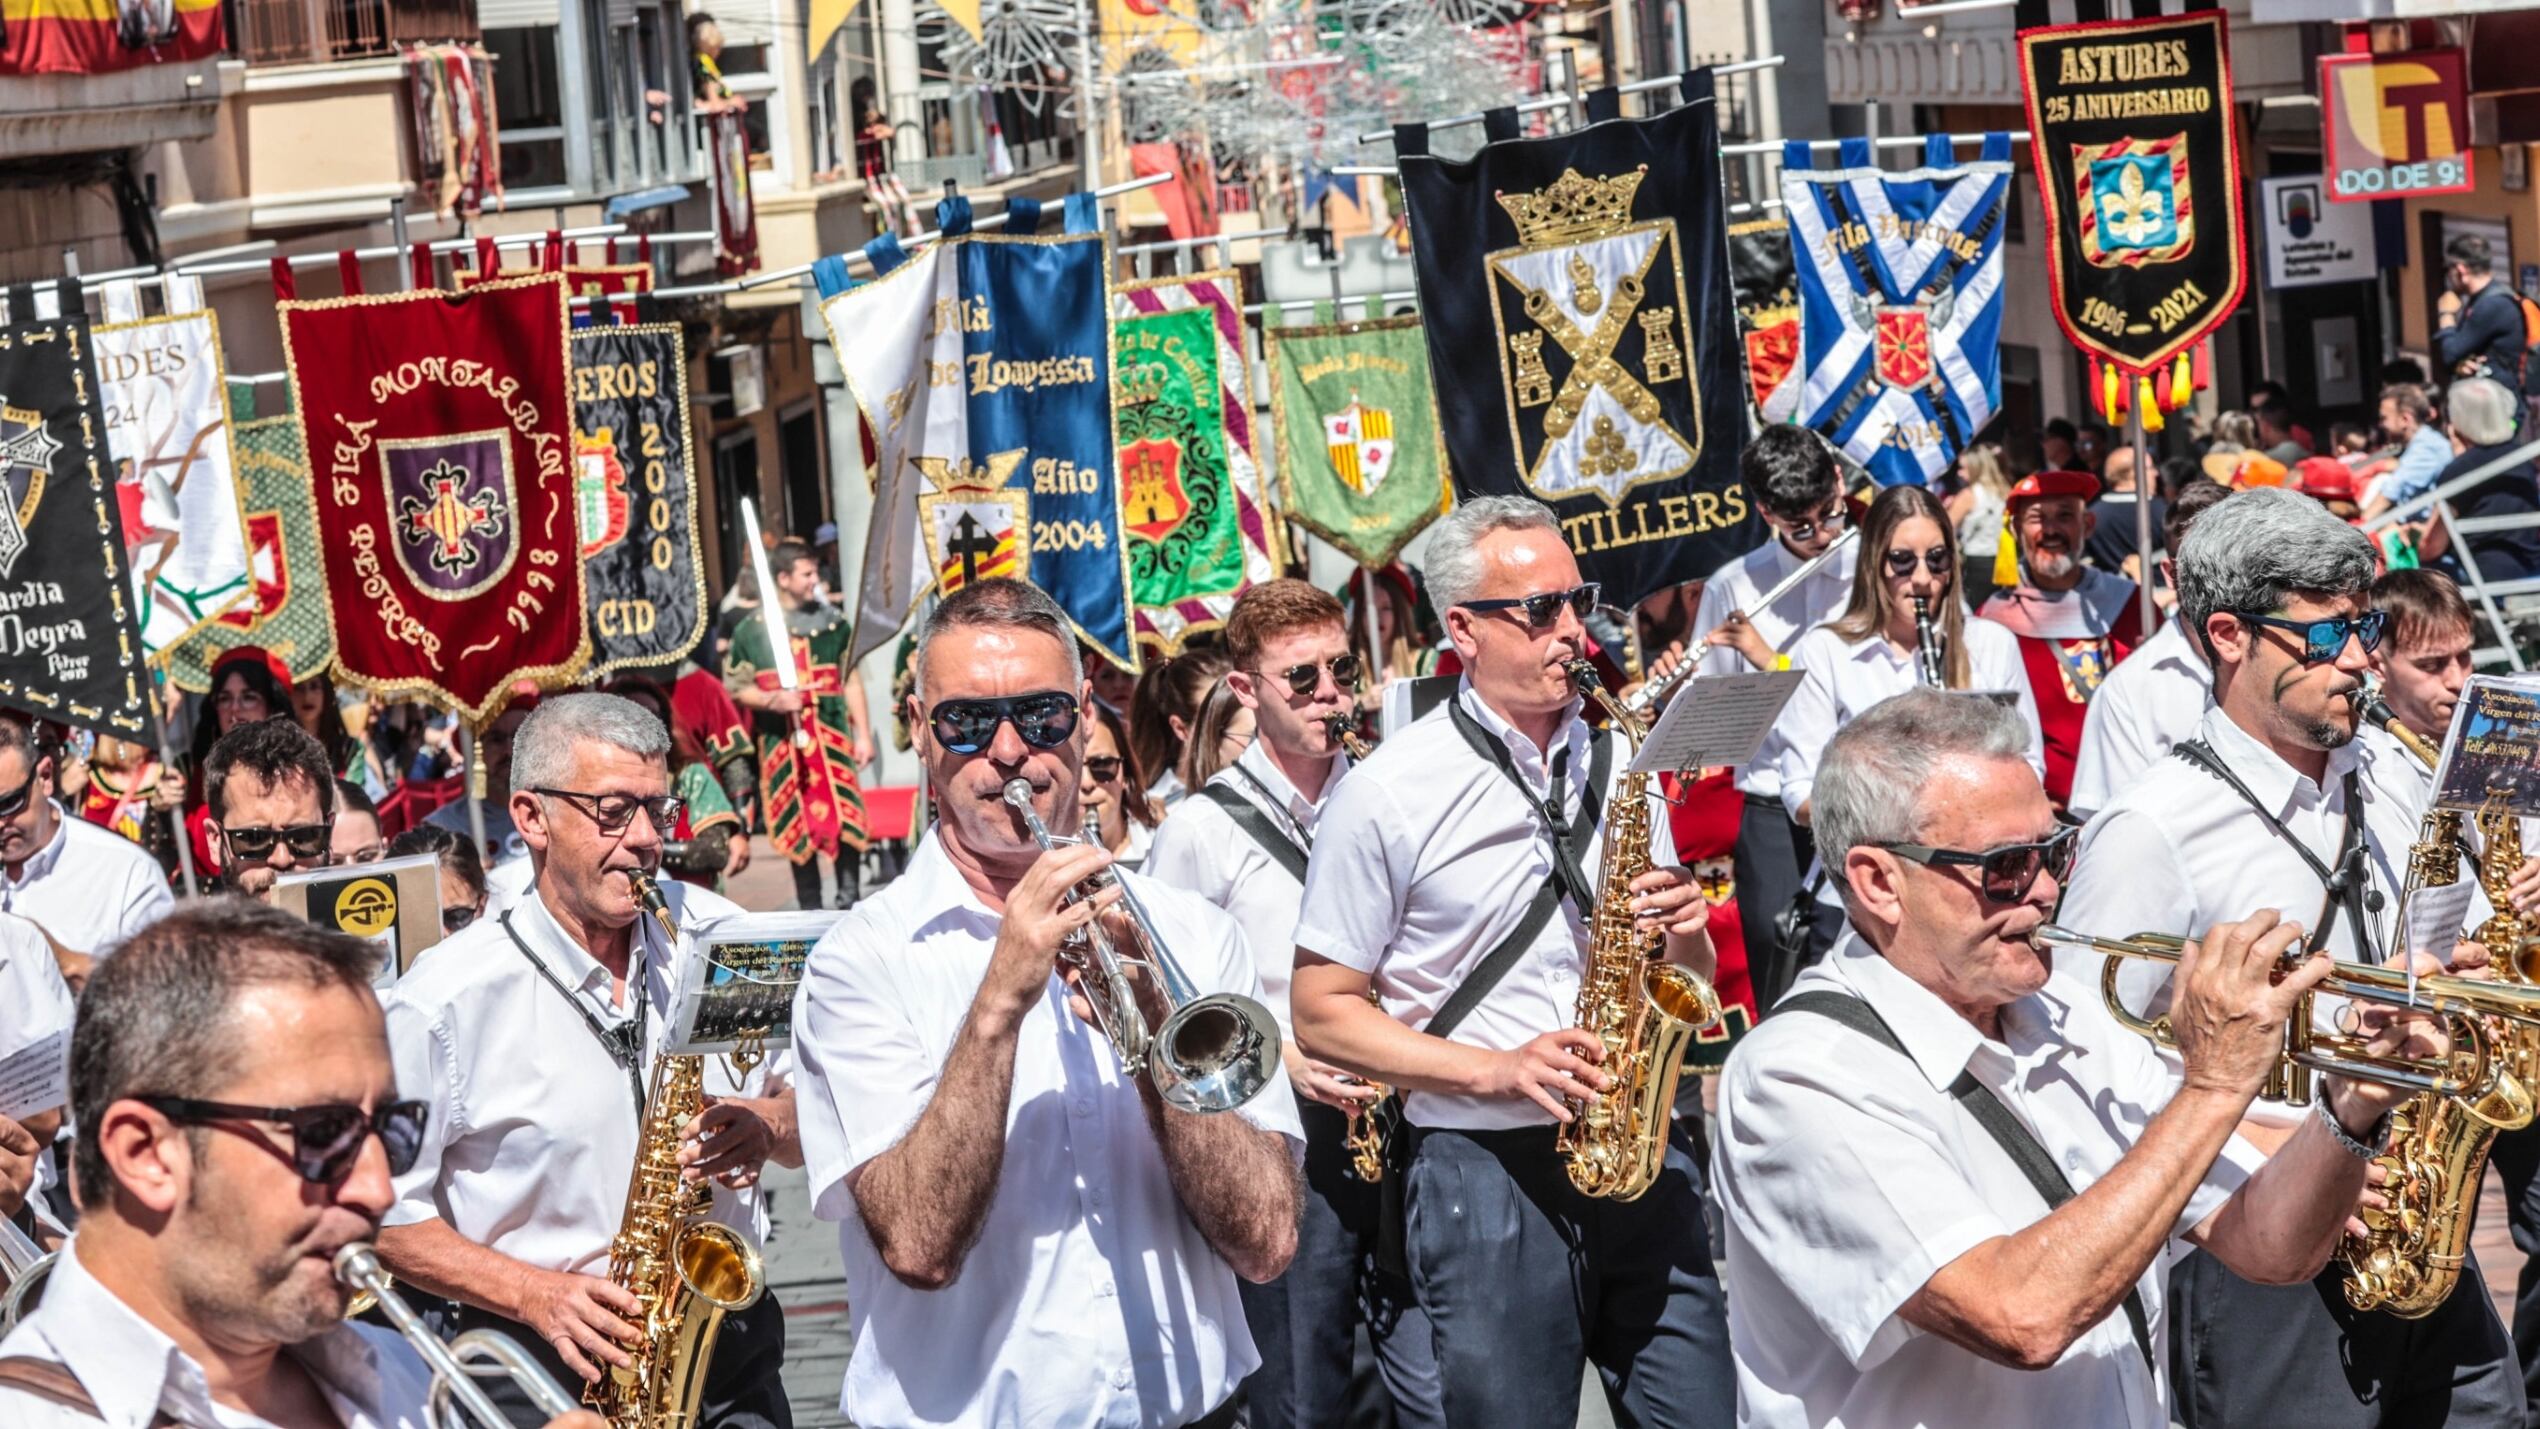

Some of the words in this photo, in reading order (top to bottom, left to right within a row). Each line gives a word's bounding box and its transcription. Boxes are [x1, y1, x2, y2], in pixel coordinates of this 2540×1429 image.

[2058, 39, 2190, 85] ASTURES
[2045, 96, 2071, 124] 25
[2073, 86, 2211, 121] ANIVERSARIO
[2391, 163, 2429, 190] DE
[966, 352, 1096, 396] Loayssa
[1032, 457, 1098, 494] Año
[1033, 519, 1107, 552] 2004
[597, 600, 656, 637] CID
